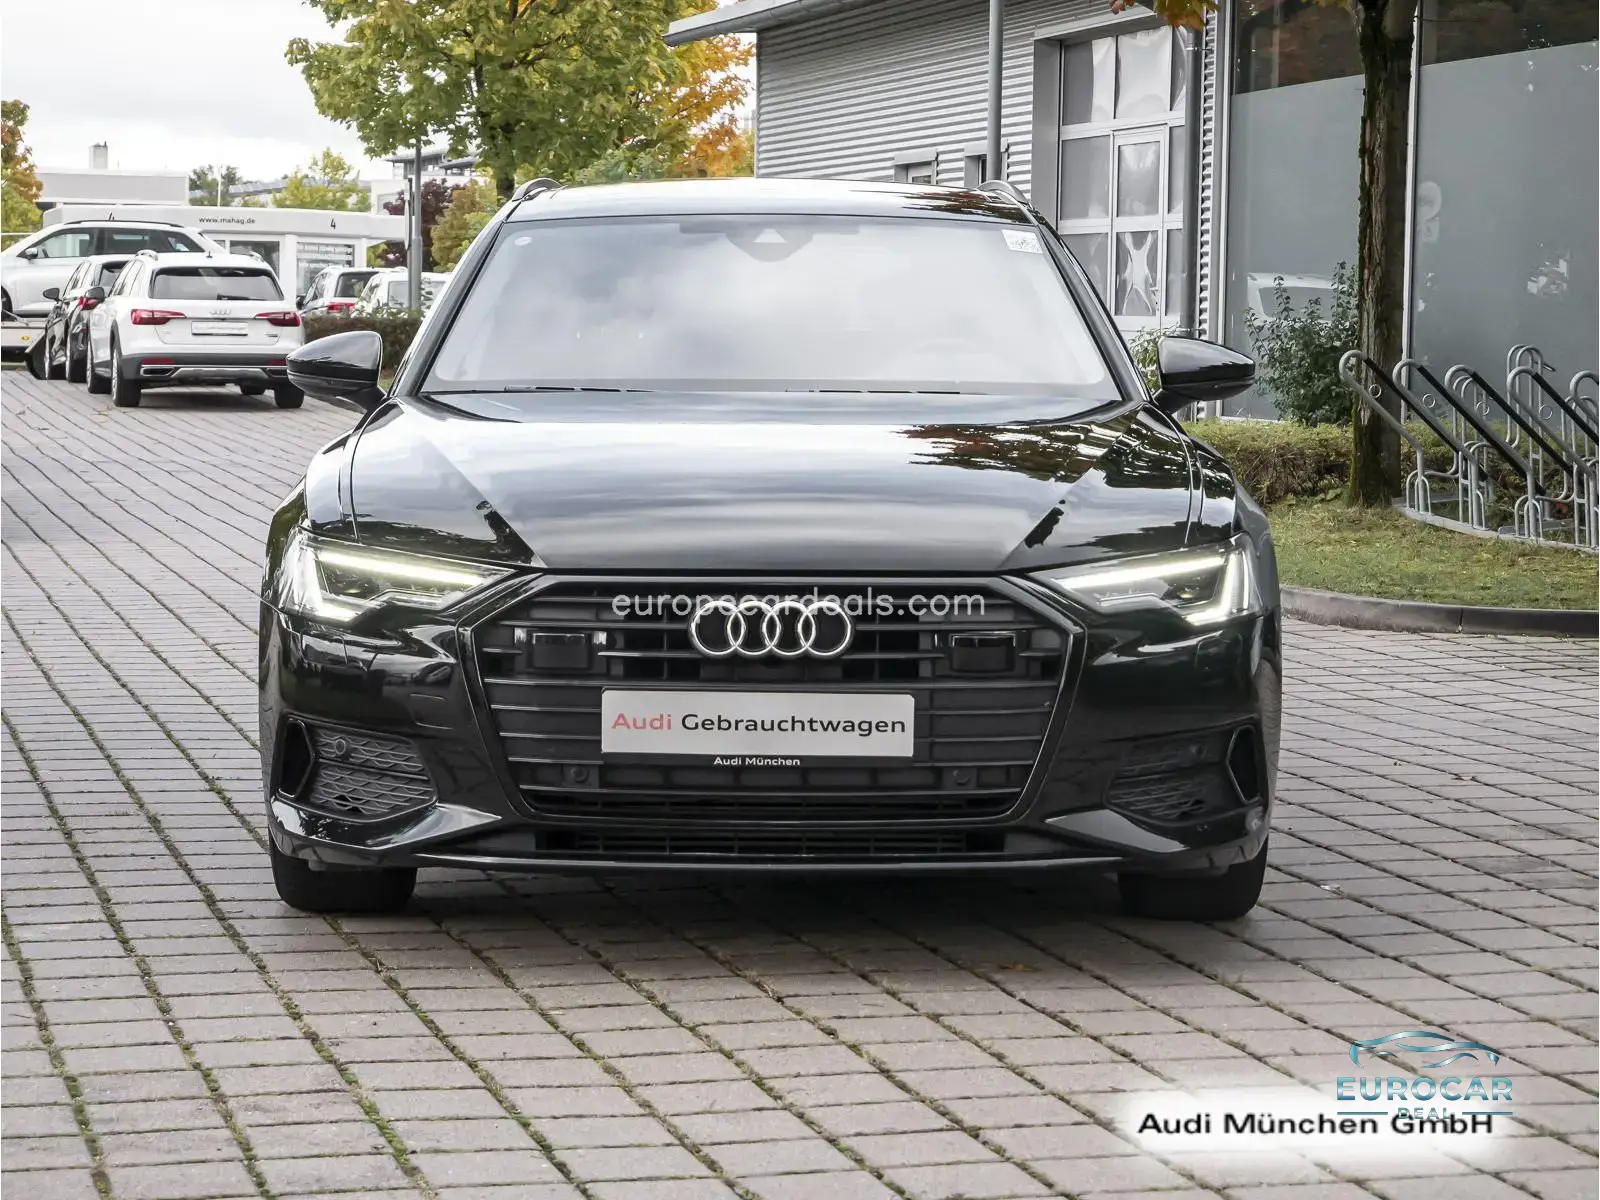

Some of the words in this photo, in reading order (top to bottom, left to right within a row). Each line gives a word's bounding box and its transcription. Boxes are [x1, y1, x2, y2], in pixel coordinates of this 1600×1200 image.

[198, 217, 256, 225] www.mahag.de
[330, 218, 336, 229] 4
[611, 712, 673, 731] Audi
[681, 713, 906, 738] Gebrauchtwagen
[713, 755, 742, 766] Audi
[745, 756, 801, 767] München
